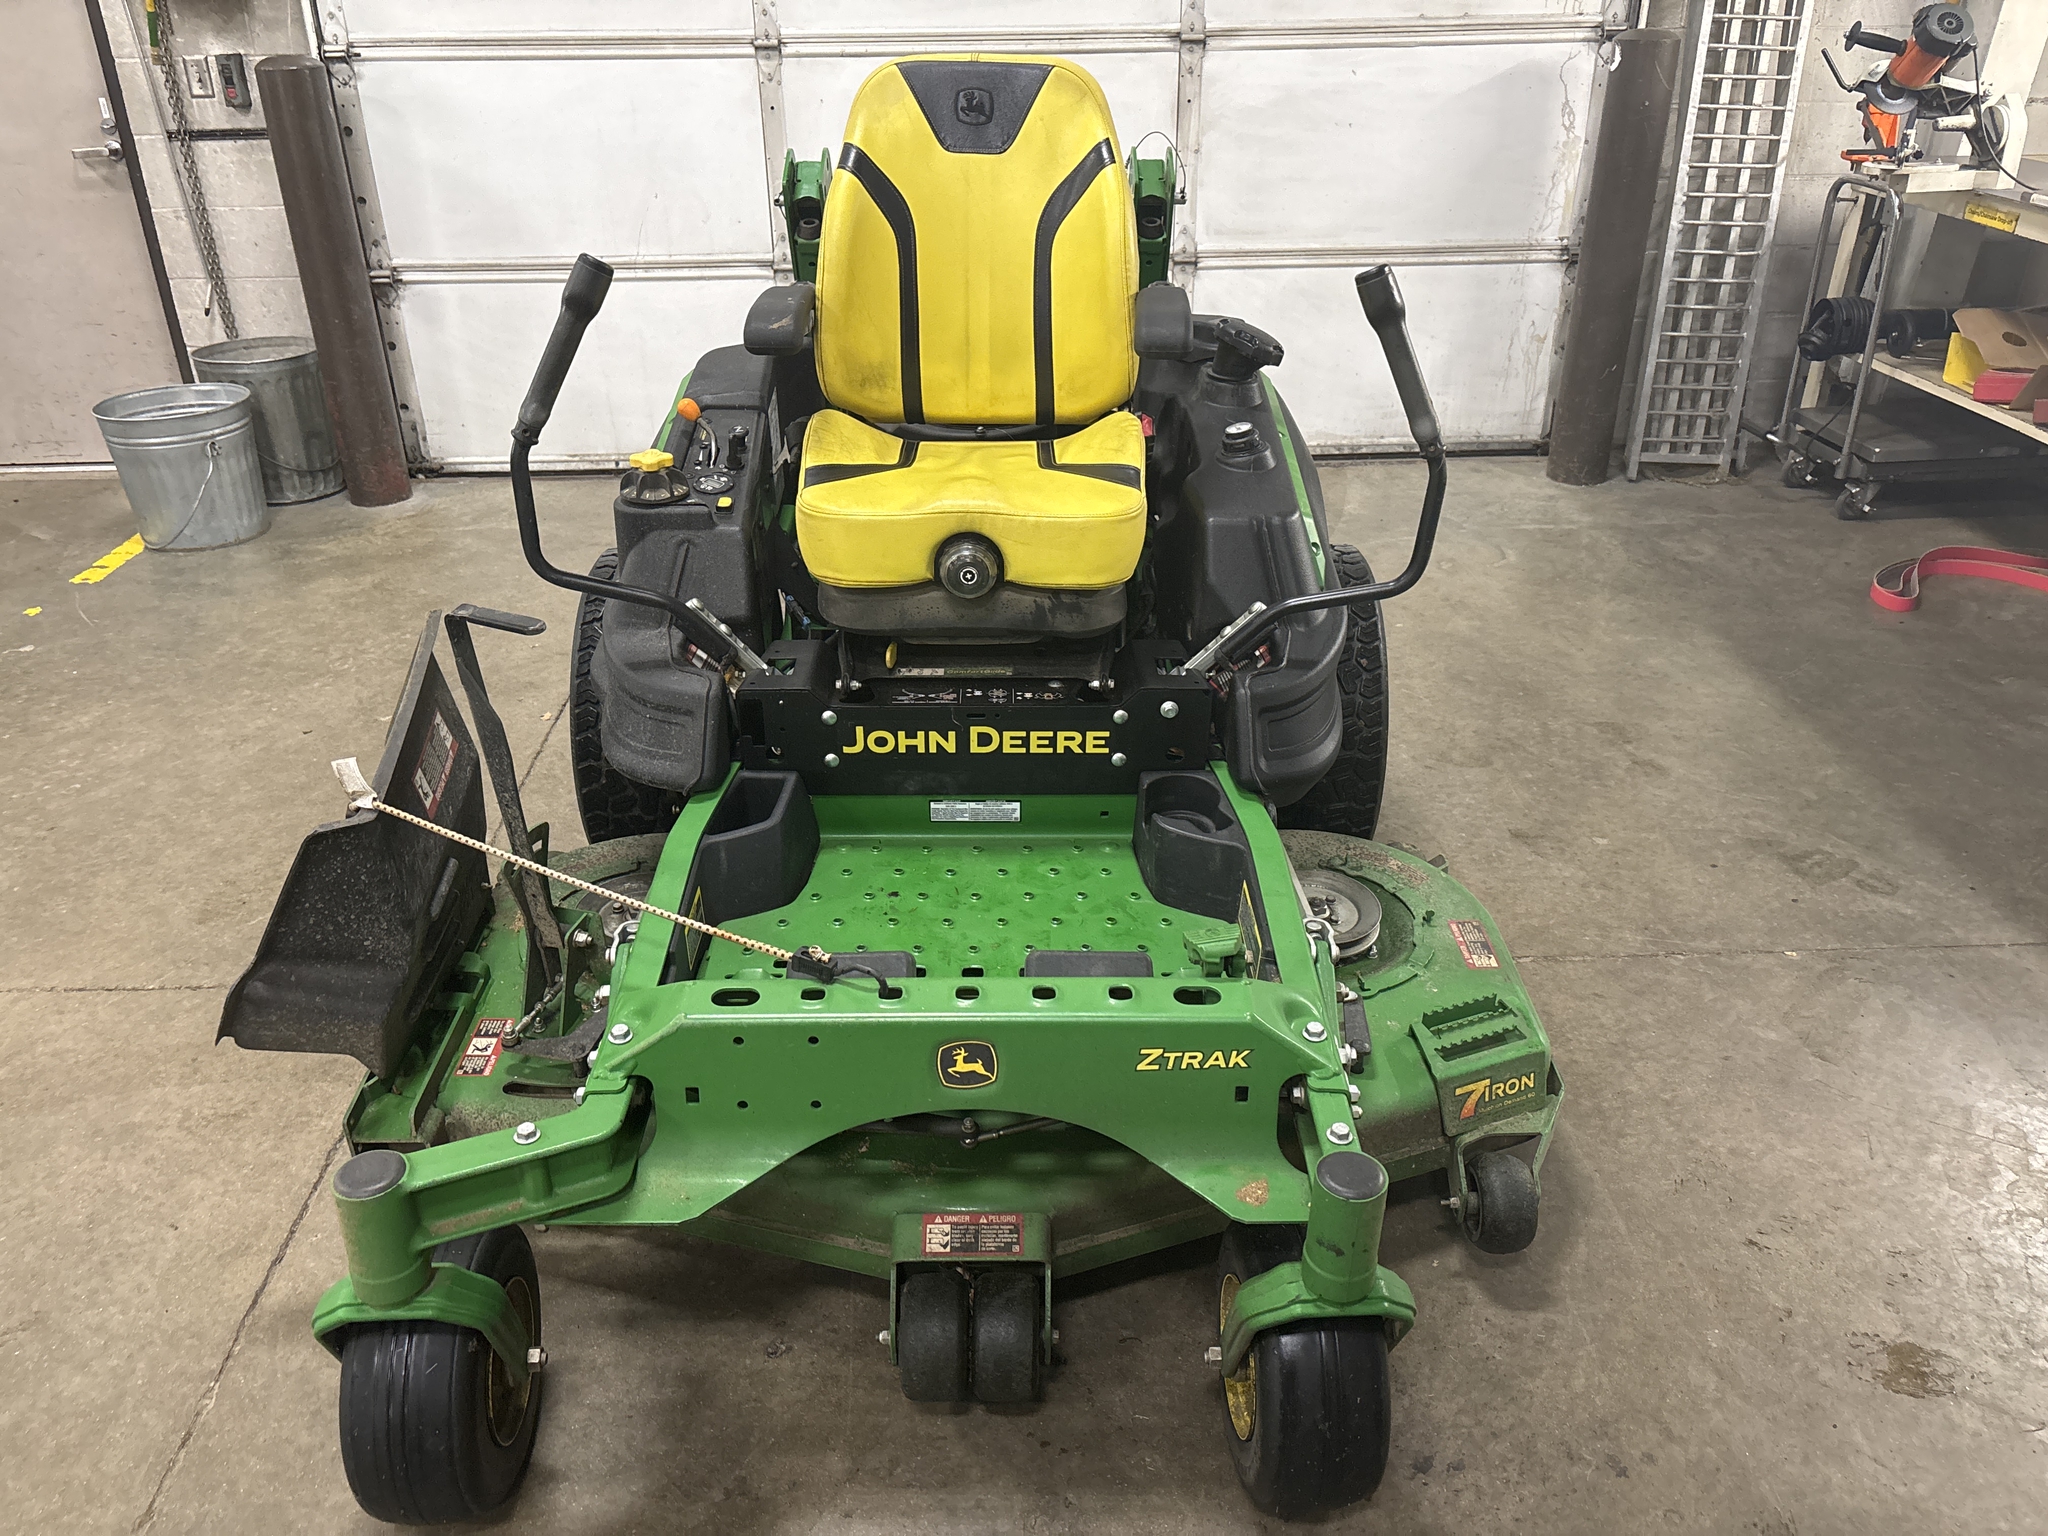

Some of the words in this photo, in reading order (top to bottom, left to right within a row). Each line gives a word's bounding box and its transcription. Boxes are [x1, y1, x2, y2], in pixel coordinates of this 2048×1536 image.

[842, 725, 956, 754] JOHN
[969, 725, 1111, 754] DEERE
[1136, 1048, 1253, 1071] ZTRAK
[943, 1215, 970, 1223] DANGER
[988, 1215, 1016, 1223] PELIGRO
